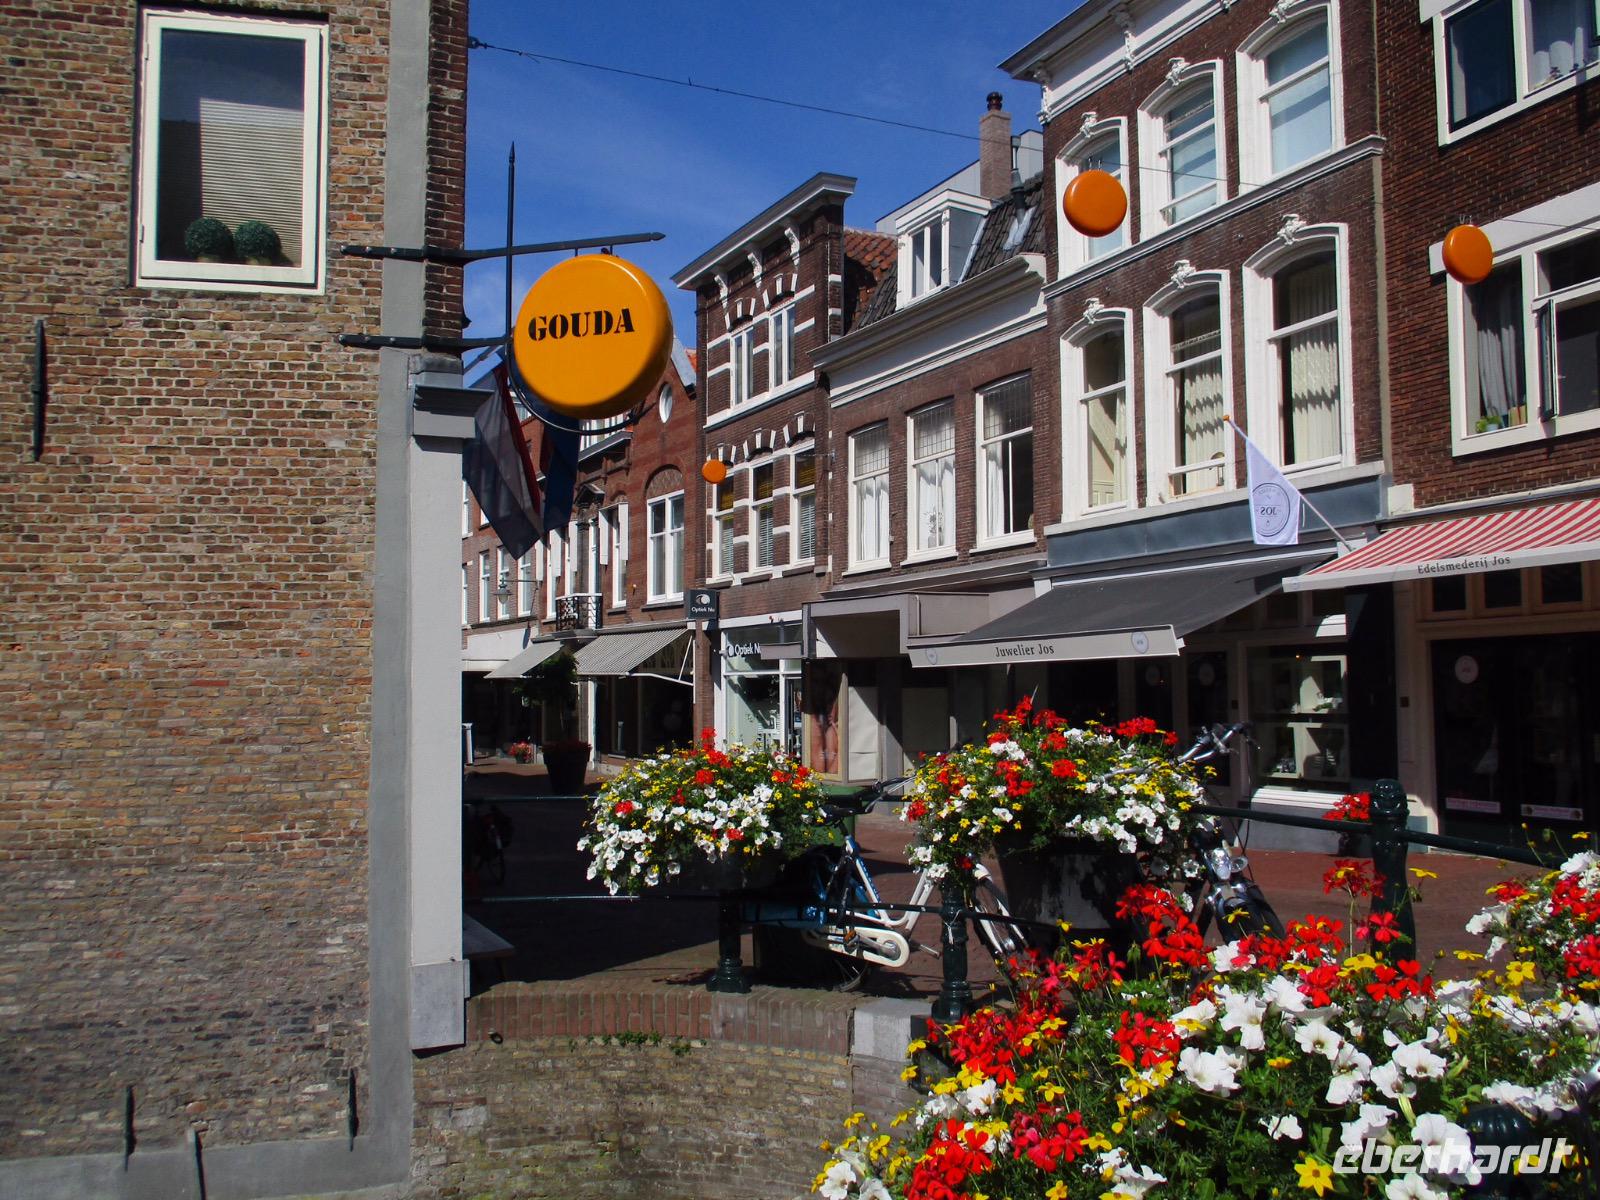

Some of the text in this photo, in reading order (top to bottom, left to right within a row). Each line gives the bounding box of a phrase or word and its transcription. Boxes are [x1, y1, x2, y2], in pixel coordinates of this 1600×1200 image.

[528, 308, 635, 341] GOUDA
[1417, 556, 1512, 575] Edelsmederij Jos
[735, 642, 754, 656] Optiek
[995, 643, 1055, 658] Juwelier Jos
